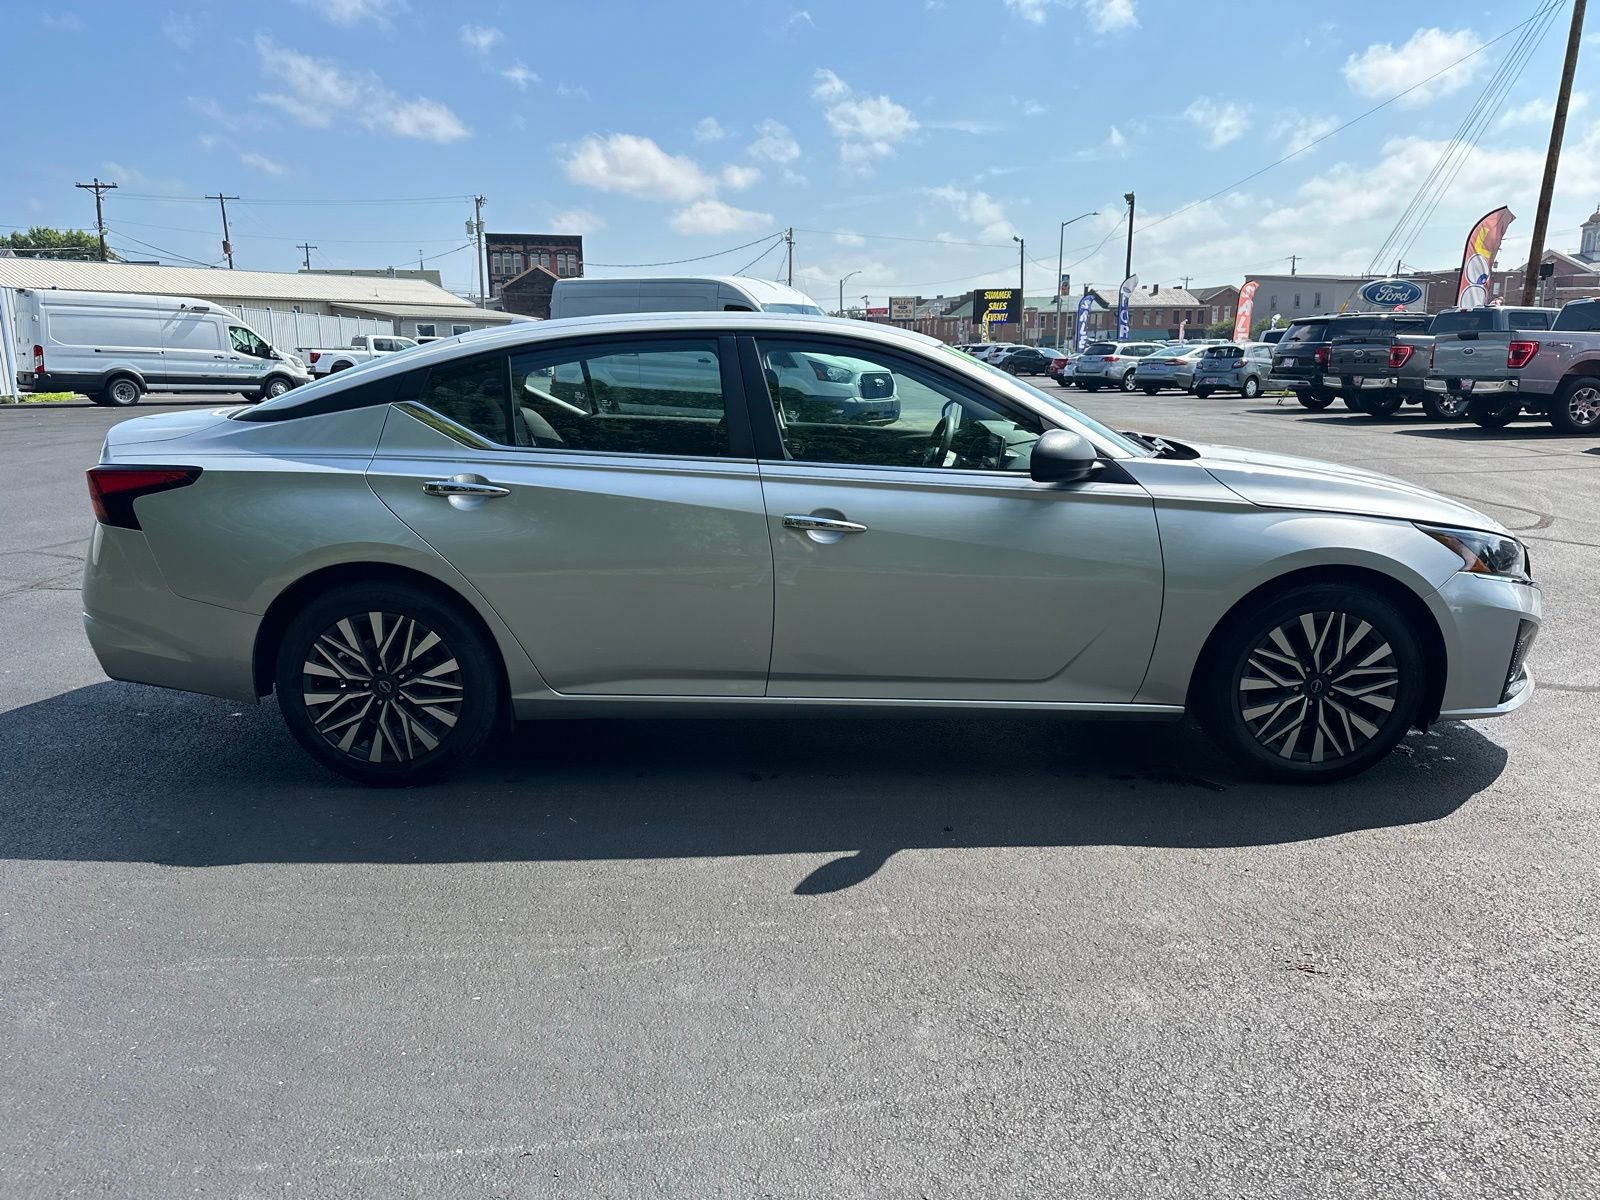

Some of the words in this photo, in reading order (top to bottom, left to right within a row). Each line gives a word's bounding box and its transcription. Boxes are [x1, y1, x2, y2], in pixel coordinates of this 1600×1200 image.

[984, 290, 1012, 299] SUMMER
[1375, 284, 1412, 302] Ford
[988, 301, 1008, 311] SALES
[987, 313, 1008, 322] EVENT!
[1078, 299, 1092, 349] SALE
